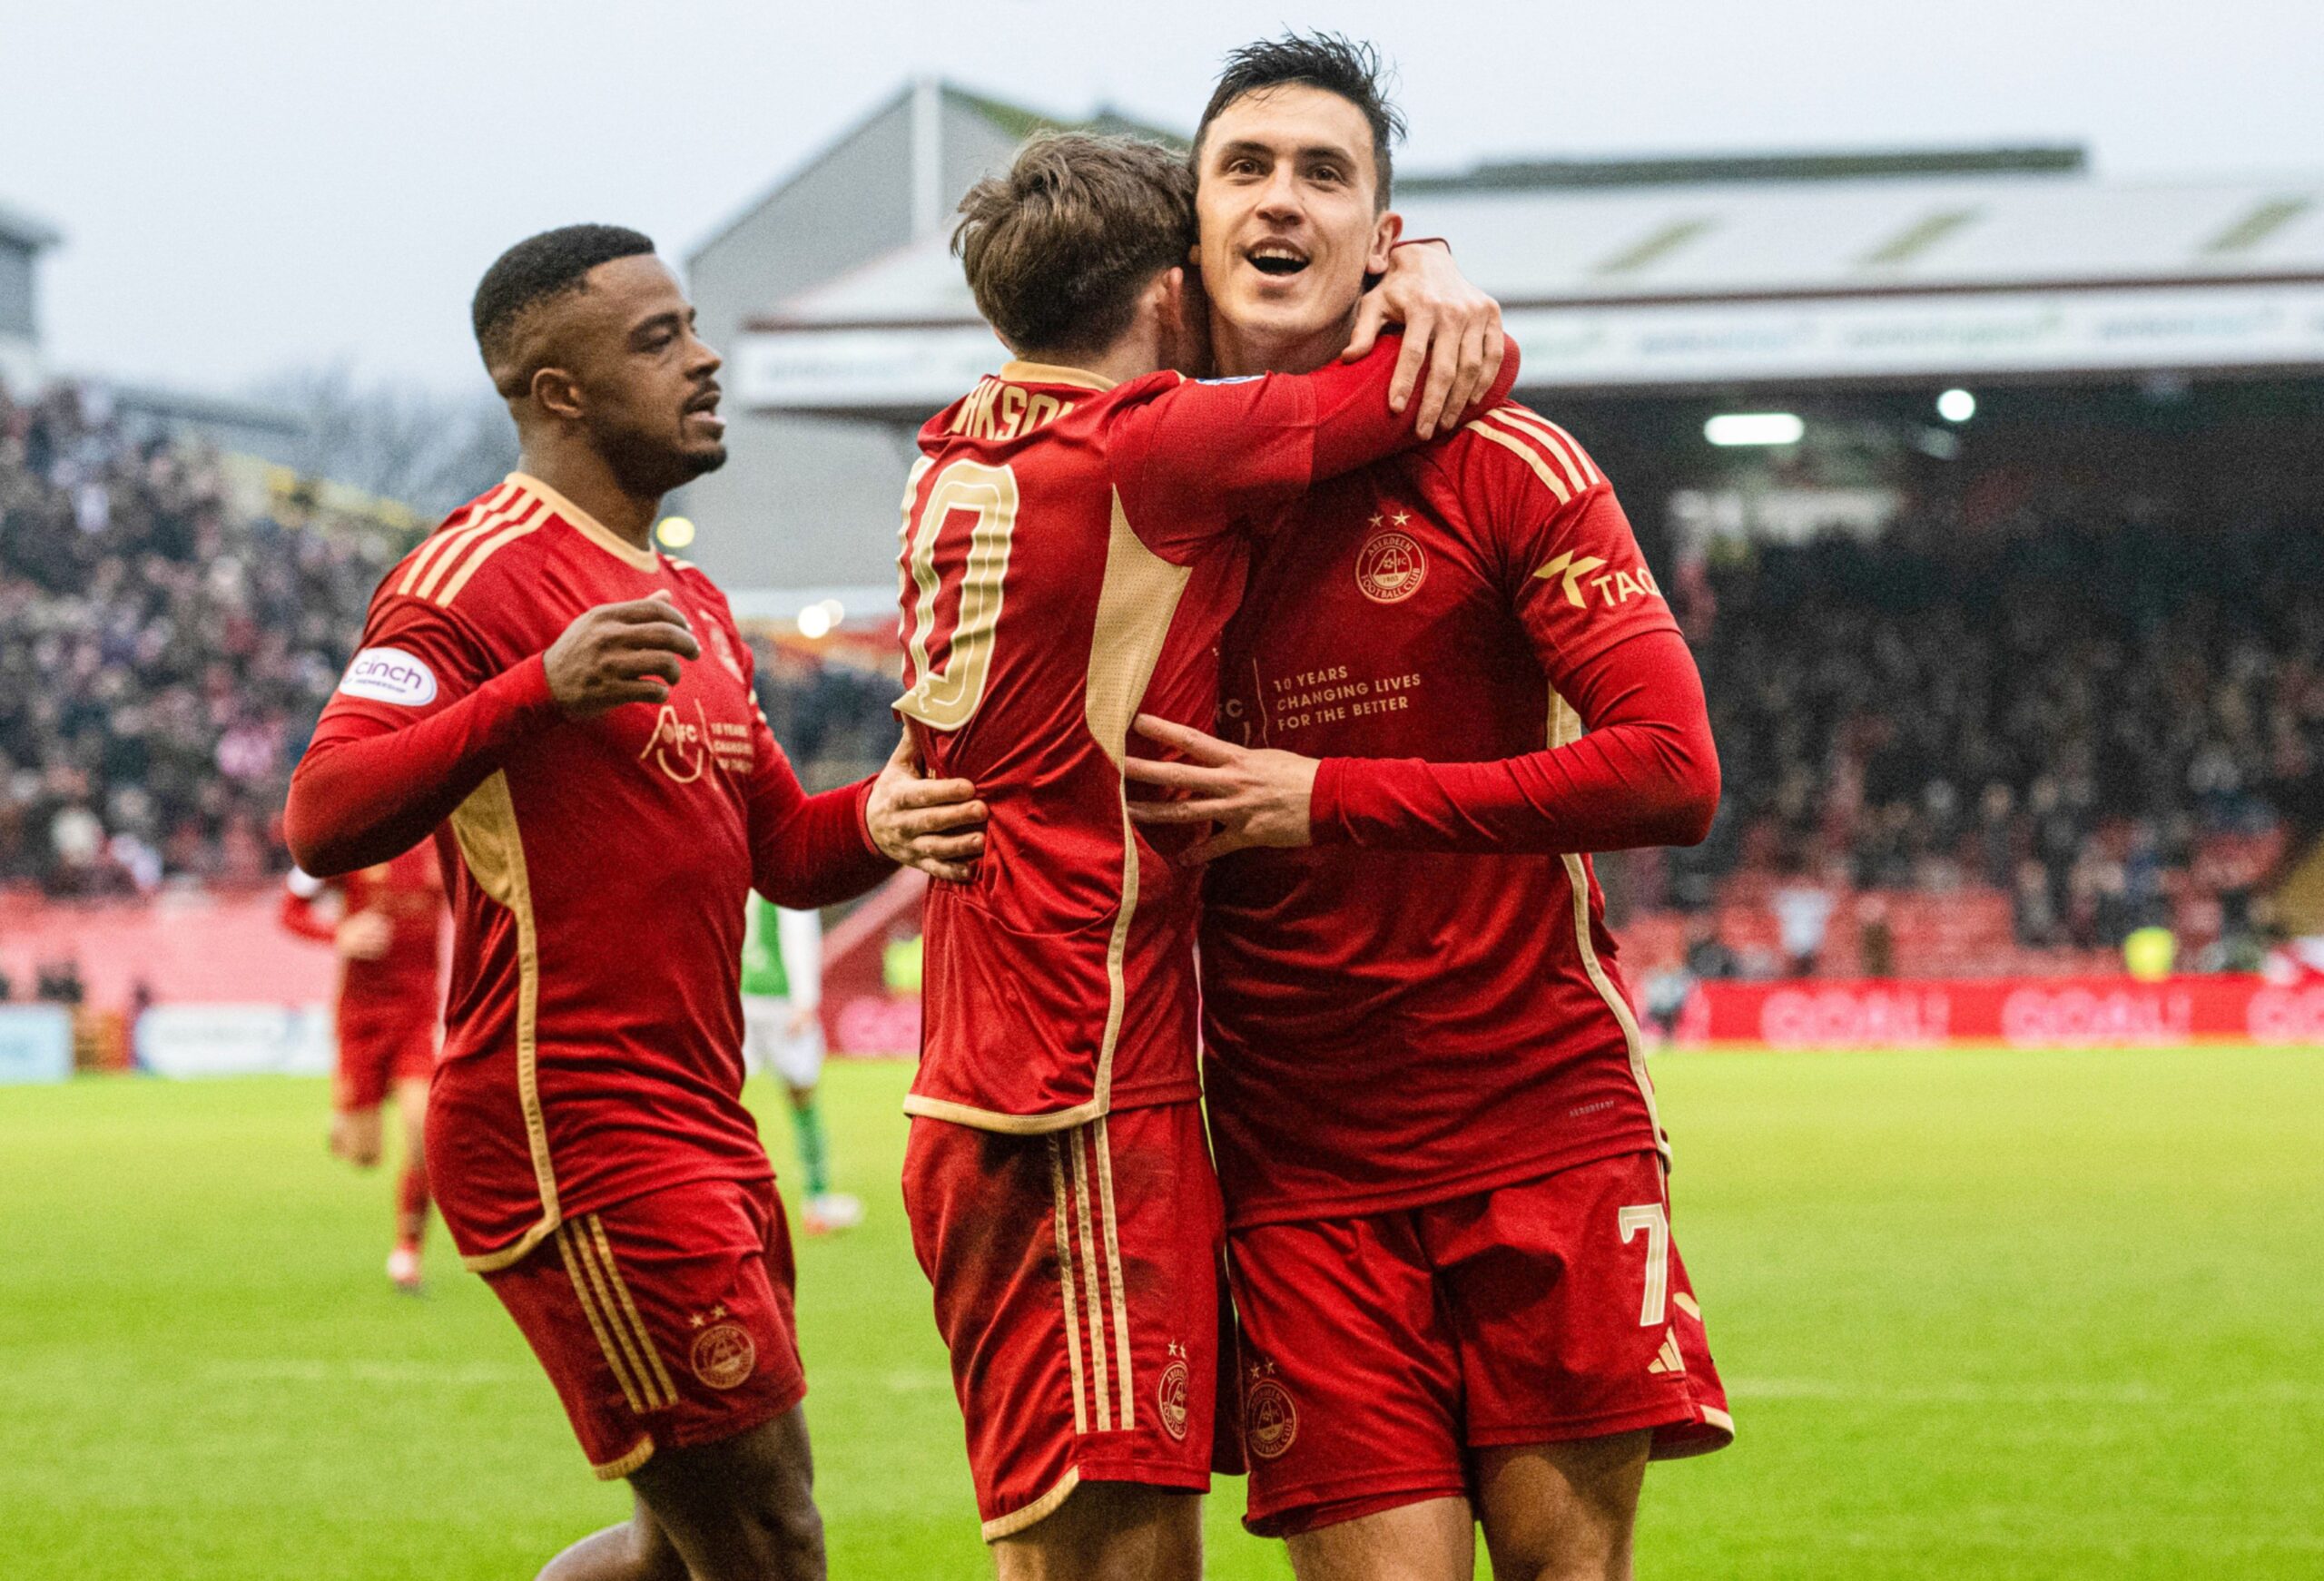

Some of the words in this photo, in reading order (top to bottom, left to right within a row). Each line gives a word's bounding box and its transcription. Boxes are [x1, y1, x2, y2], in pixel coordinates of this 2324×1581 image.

[1367, 536, 1413, 556] ABERDEEN
[1361, 574, 1404, 599] FOOTBALL
[1403, 567, 1421, 591] CLUB
[1590, 566, 1662, 607] TAQ
[355, 655, 422, 689] cinch
[1274, 678, 1292, 692] 10
[1296, 665, 1348, 687] YEARS
[1277, 682, 1369, 712] CHANGING
[1375, 673, 1422, 692] LIVES
[1277, 713, 1311, 732] FOR
[1316, 706, 1346, 723] THE
[1353, 695, 1409, 717] BETTER
[1618, 1203, 1669, 1327] 7
